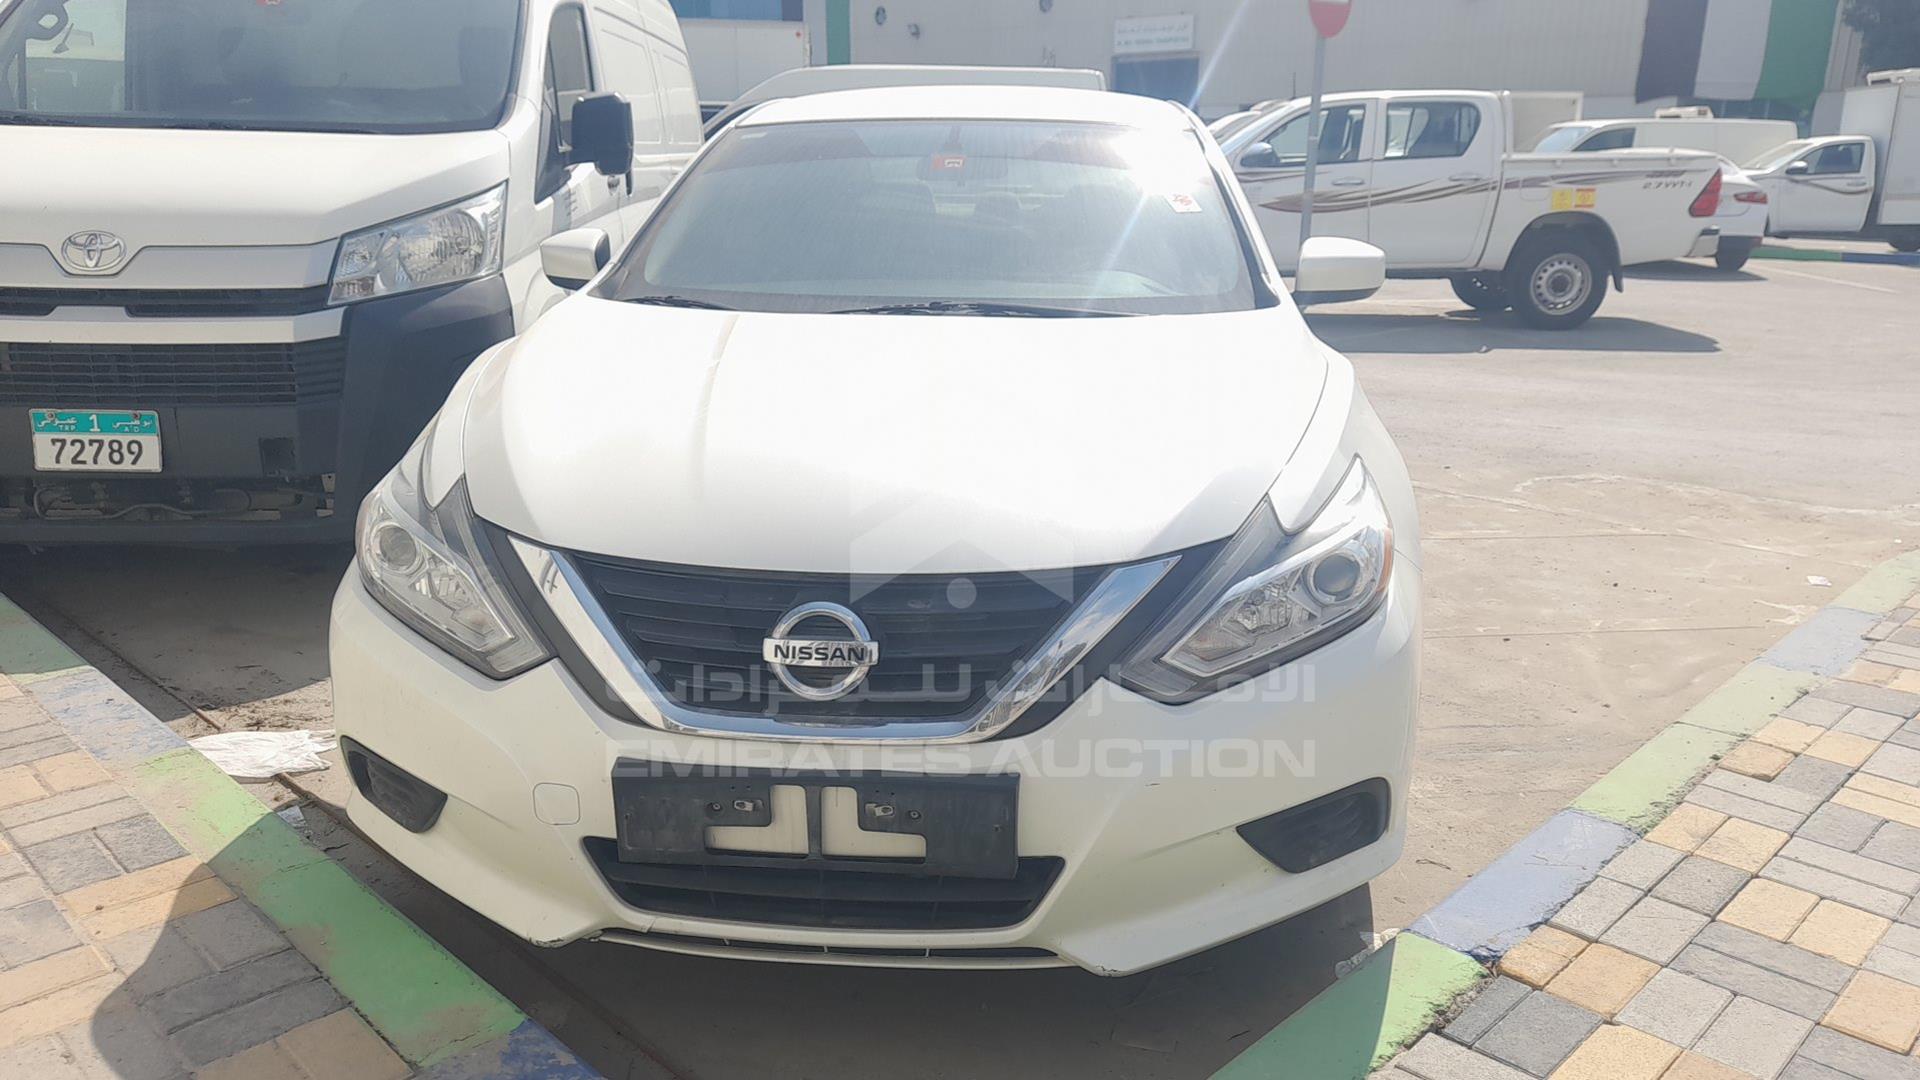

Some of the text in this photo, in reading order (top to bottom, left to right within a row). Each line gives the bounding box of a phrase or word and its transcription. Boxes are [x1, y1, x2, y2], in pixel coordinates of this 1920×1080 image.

[88, 414, 101, 432] 1
[50, 438, 143, 465] 72789
[774, 644, 865, 661] NISSAN
